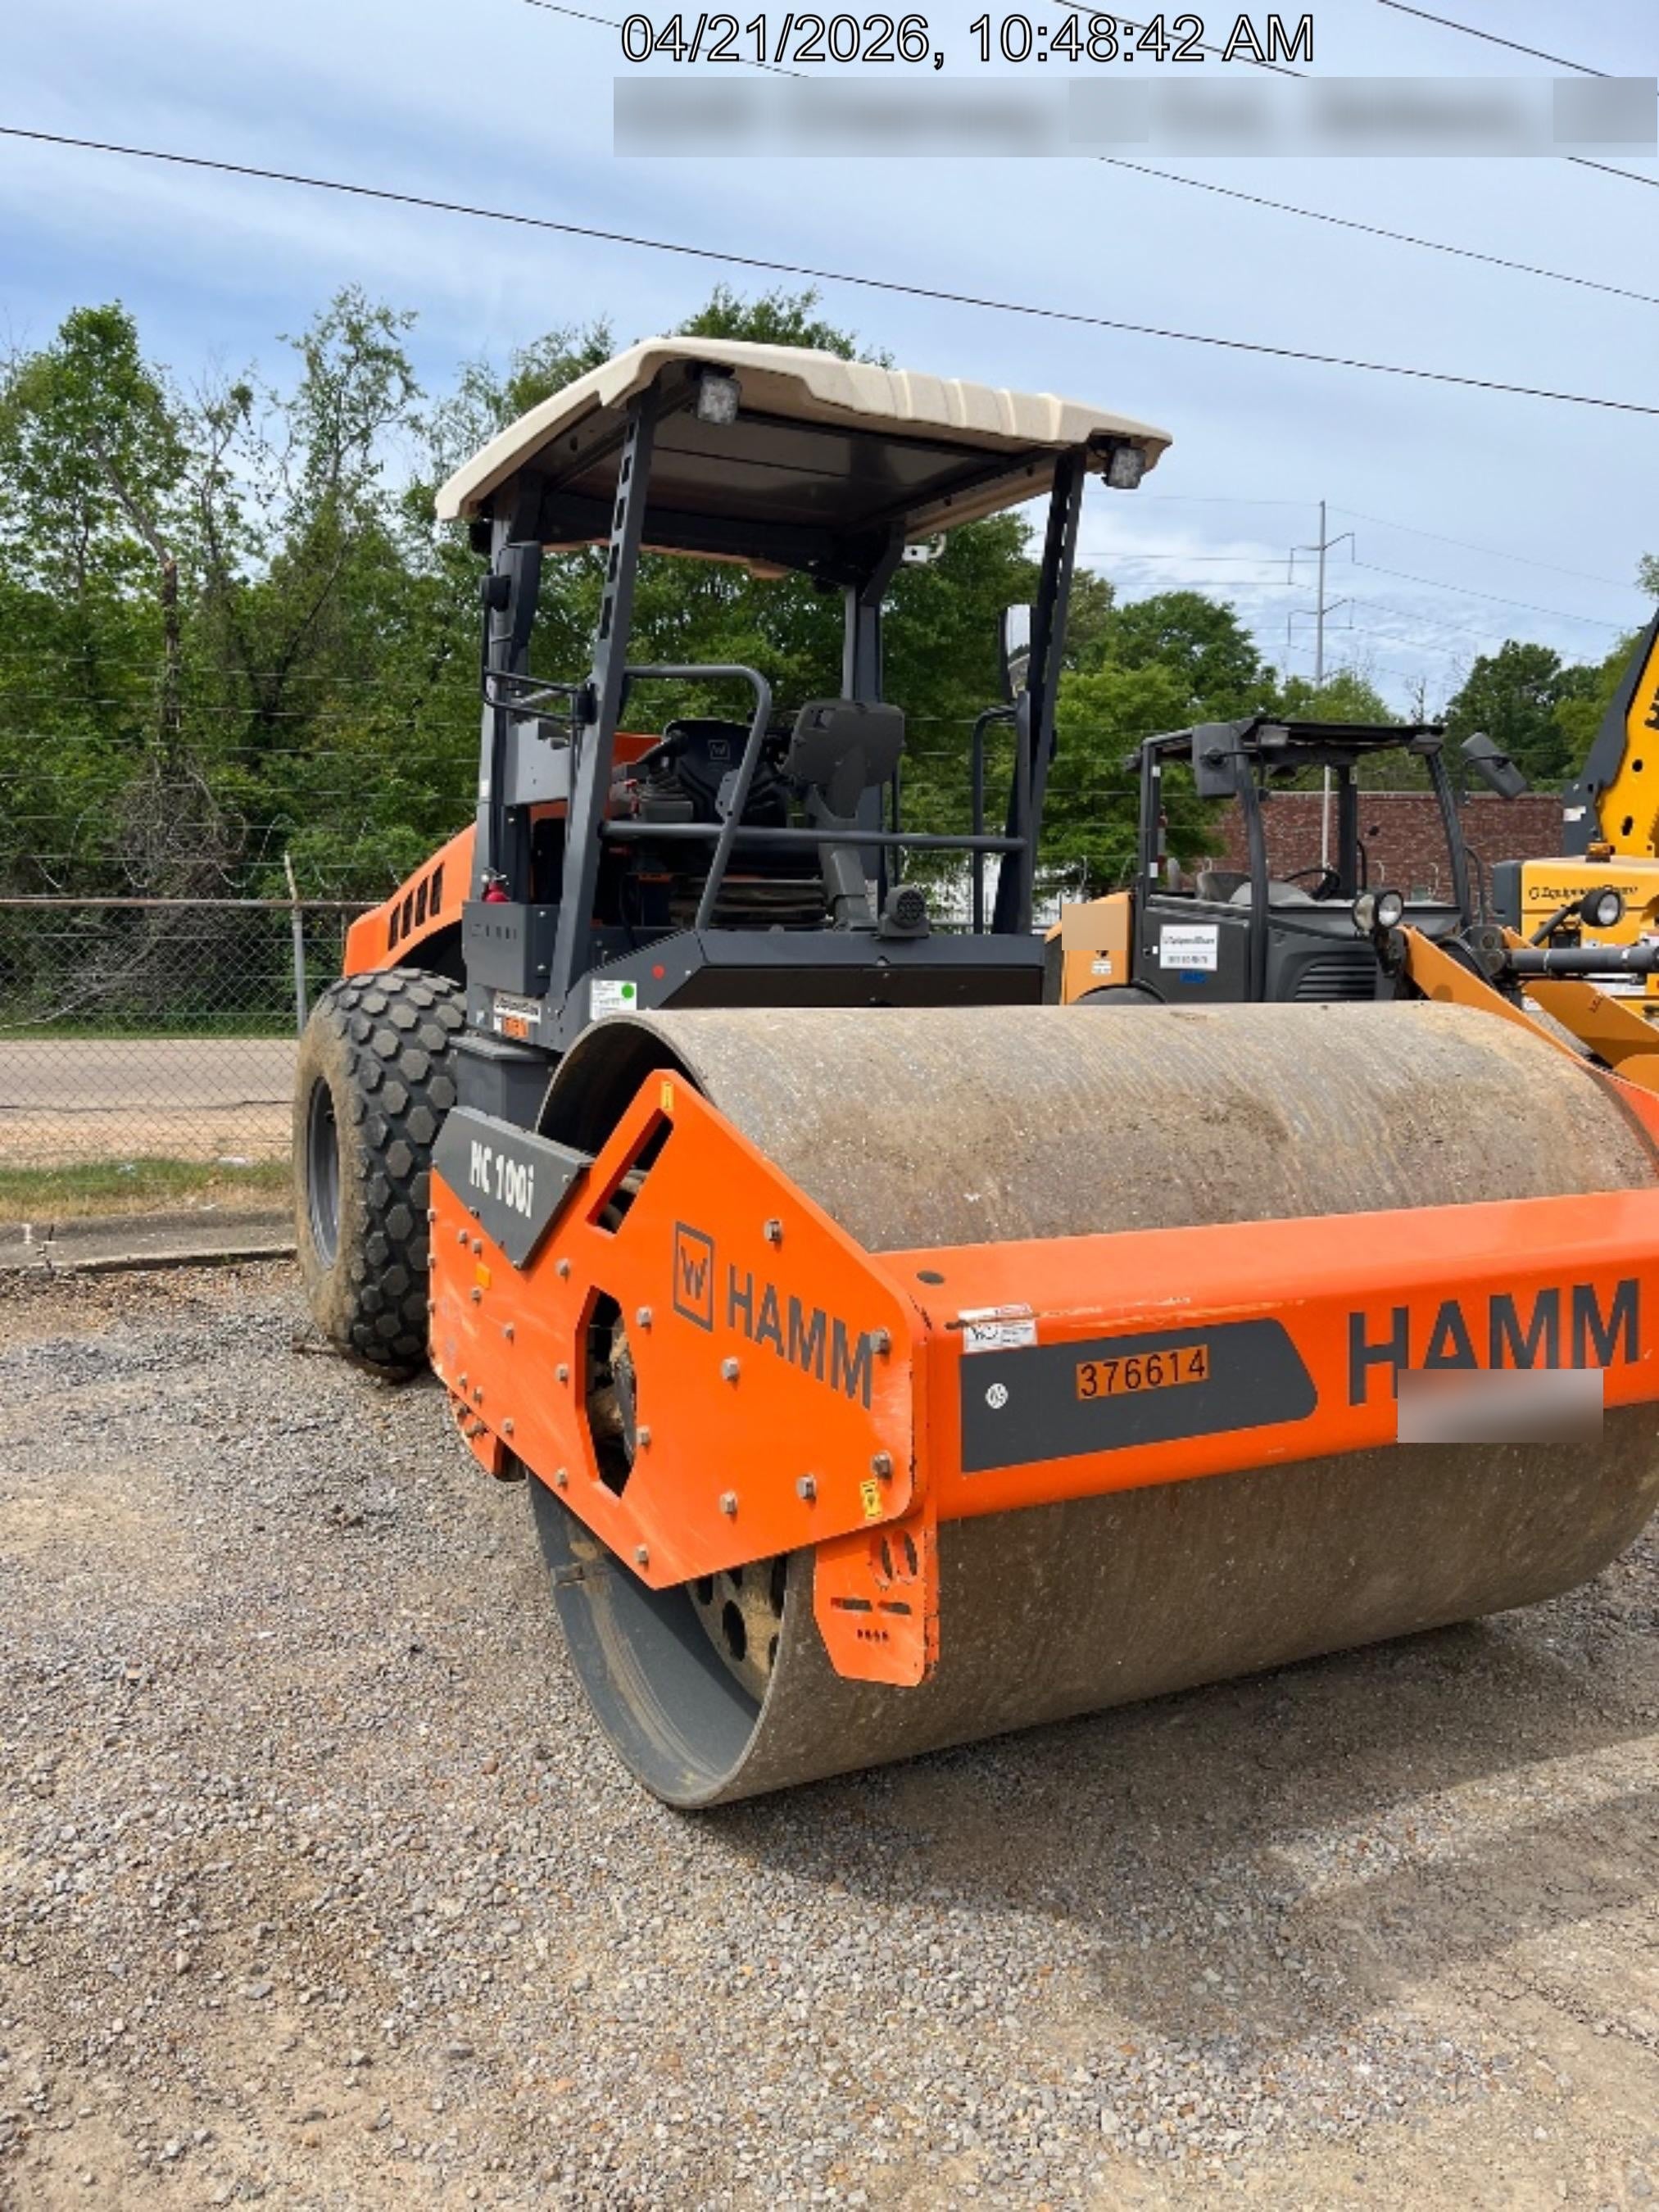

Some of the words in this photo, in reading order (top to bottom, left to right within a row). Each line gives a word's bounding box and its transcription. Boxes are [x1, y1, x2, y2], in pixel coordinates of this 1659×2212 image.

[496, 1154, 534, 1219] 100i
[728, 1263, 874, 1411] HAMM
[1081, 1349, 1205, 1396] 376614
[1349, 1277, 1640, 1407] HAMM
